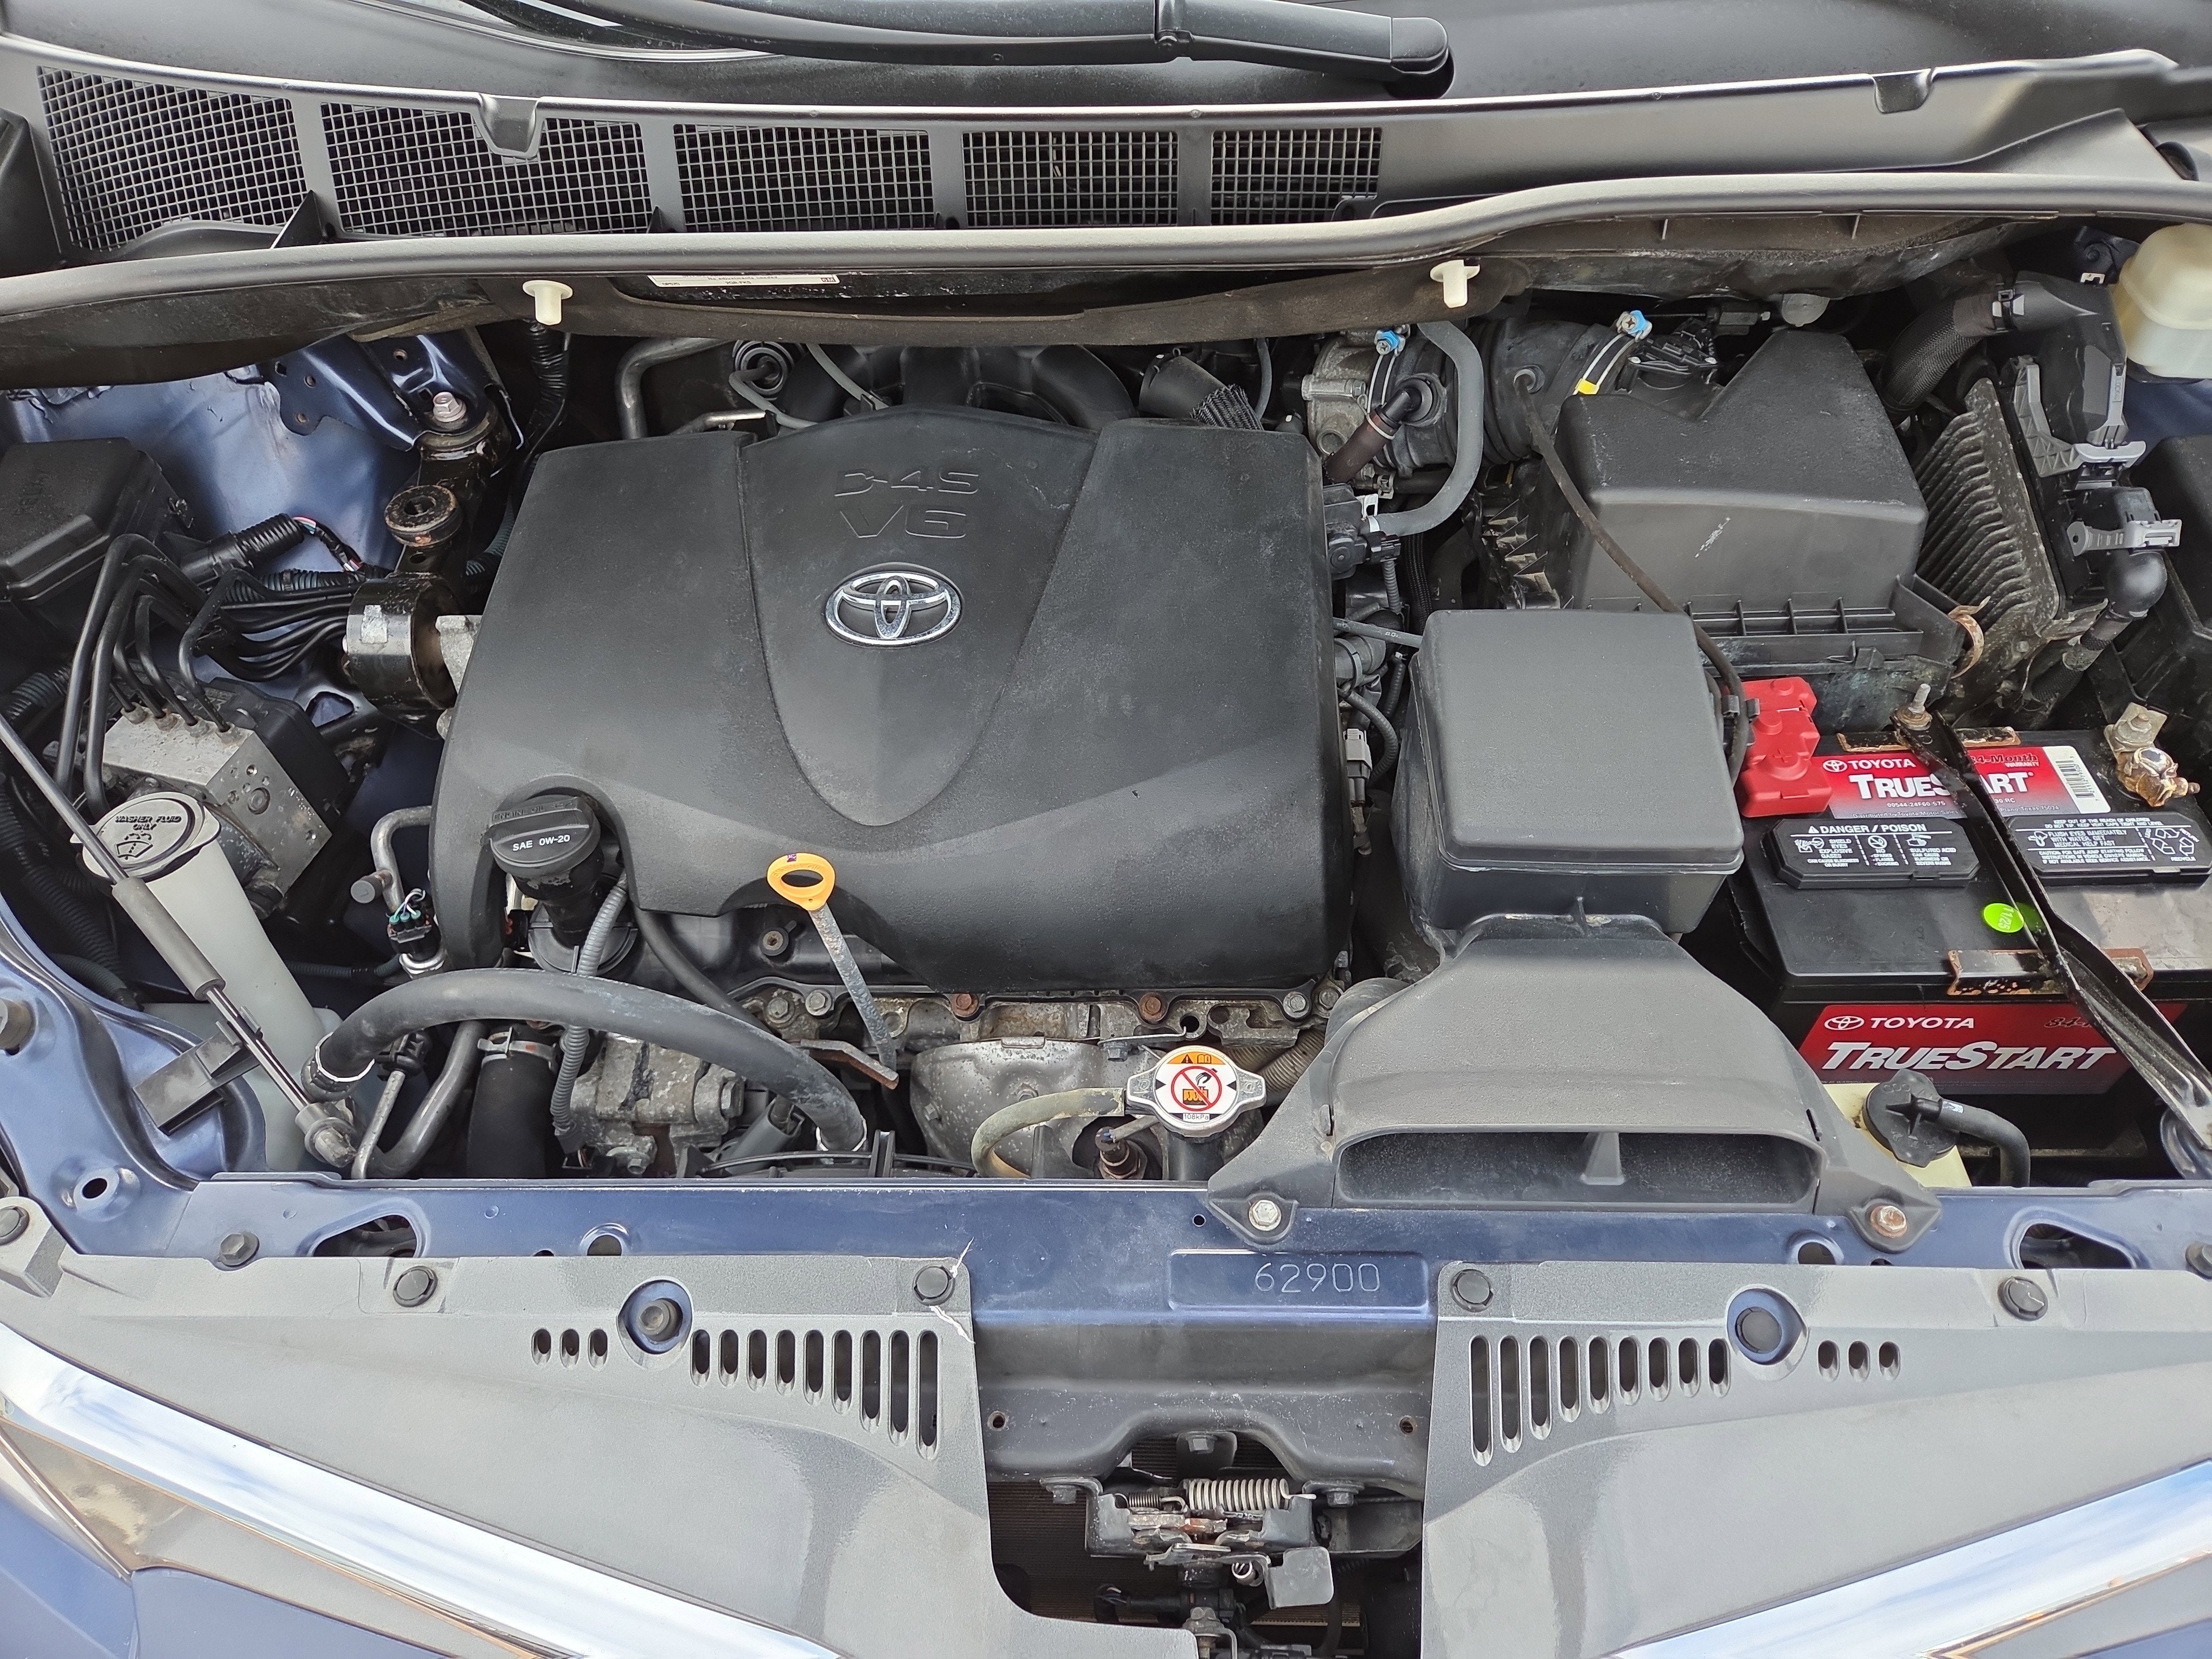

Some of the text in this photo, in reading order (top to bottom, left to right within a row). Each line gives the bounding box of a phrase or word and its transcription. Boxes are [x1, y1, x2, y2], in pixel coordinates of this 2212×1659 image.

[839, 504, 967, 539] V6
[1848, 758, 1917, 770] TOYOTA
[493, 808, 527, 820] ENGIN
[1821, 825, 1869, 833] DANGER
[1881, 824, 1927, 832] POISON
[512, 834, 570, 851] SAE 0W-20
[1870, 1017, 1975, 1029] TOYOTA
[1255, 1262, 1381, 1294] 62900
